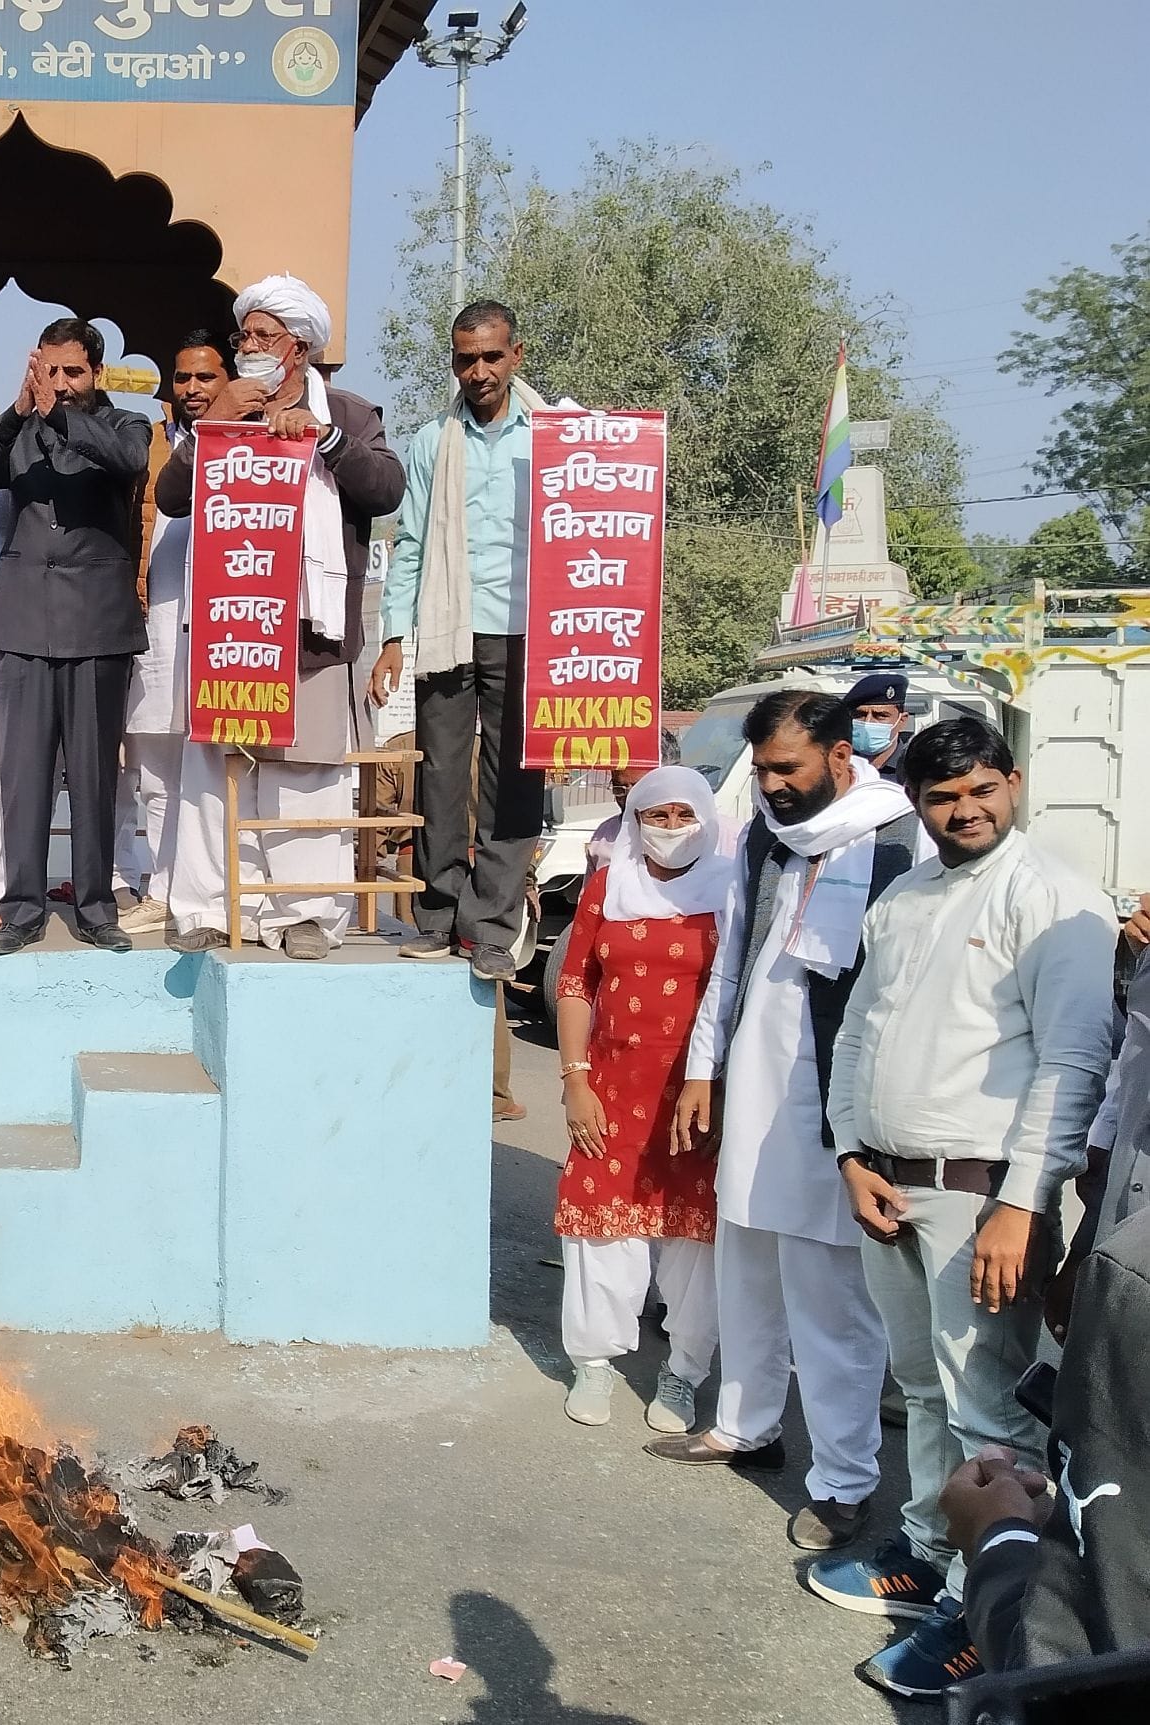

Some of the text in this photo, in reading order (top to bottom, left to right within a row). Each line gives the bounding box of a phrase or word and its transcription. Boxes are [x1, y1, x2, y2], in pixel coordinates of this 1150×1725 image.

[31, 41, 95, 78] बेटी
[203, 445, 306, 490] इण्डिया
[539, 451, 659, 498] इण्डिया
[203, 494, 298, 534] किसान
[541, 502, 655, 543] किसान
[224, 539, 276, 577] खेत
[566, 548, 628, 589] खेत
[208, 595, 287, 635] मजदूर
[548, 607, 646, 647] मजदूर
[207, 632, 284, 672] संगठन
[548, 646, 643, 685] संगठन
[196, 679, 290, 713] AIKKMS
[532, 696, 653, 729] AIKKMS
[211, 717, 272, 745] (M)
[552, 736, 630, 770] (M)
